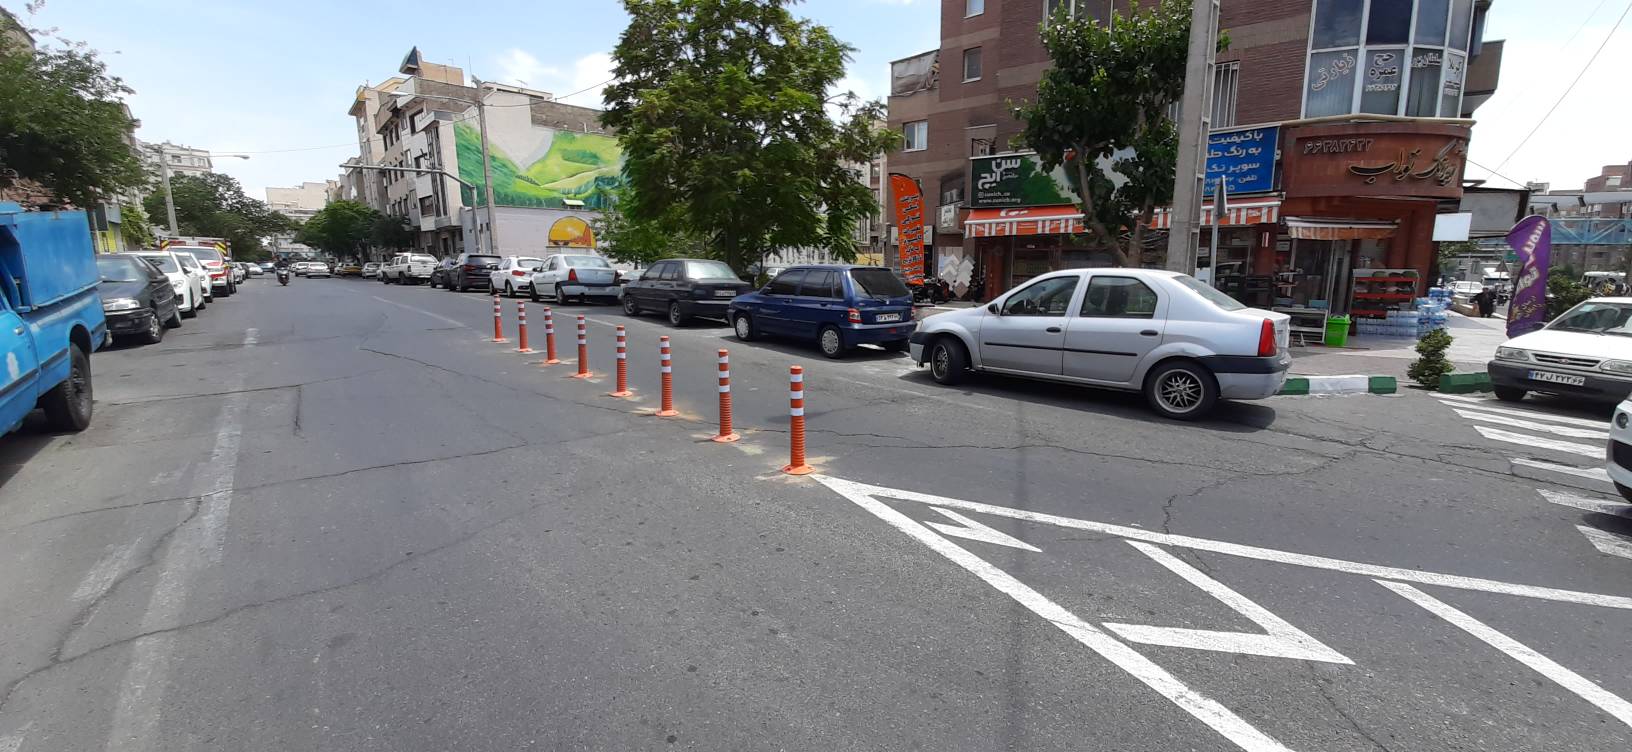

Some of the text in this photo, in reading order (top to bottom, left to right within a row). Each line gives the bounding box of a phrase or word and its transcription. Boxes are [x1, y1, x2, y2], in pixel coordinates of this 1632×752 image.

[1374, 52, 1395, 67] حج
[1369, 67, 1398, 81] عمره
[1228, 162, 1260, 174] سوپر
